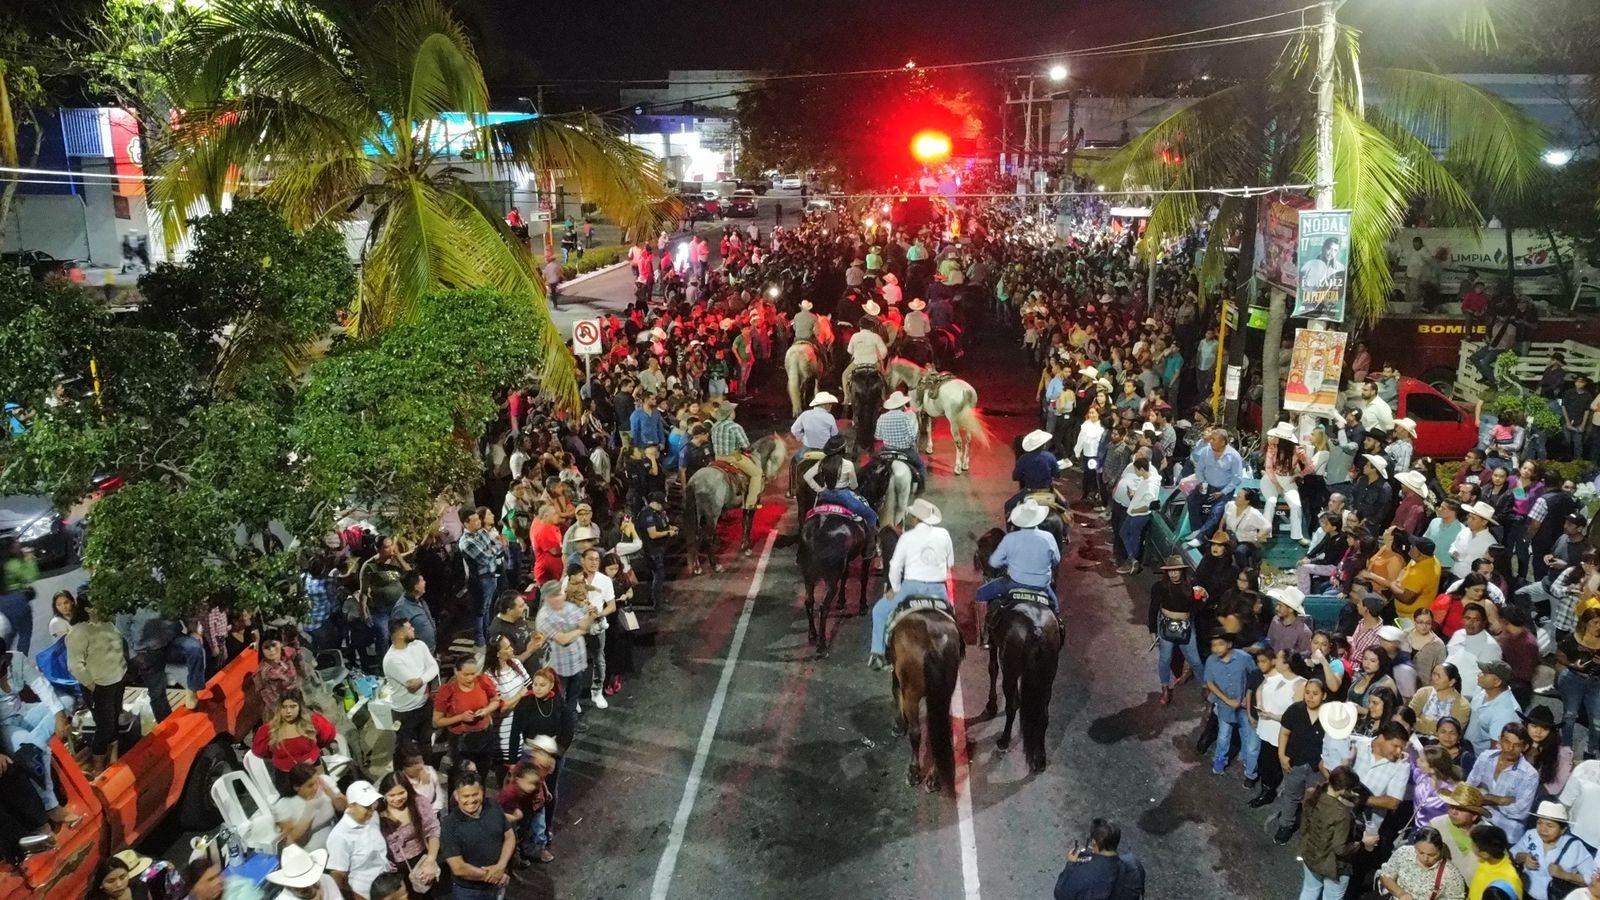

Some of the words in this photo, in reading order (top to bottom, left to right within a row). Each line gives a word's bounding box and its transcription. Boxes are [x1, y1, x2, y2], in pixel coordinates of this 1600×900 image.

[1302, 217, 1348, 233] NODAL
[1301, 238, 1309, 252] 17
[1451, 253, 1492, 263] LIMPIA
